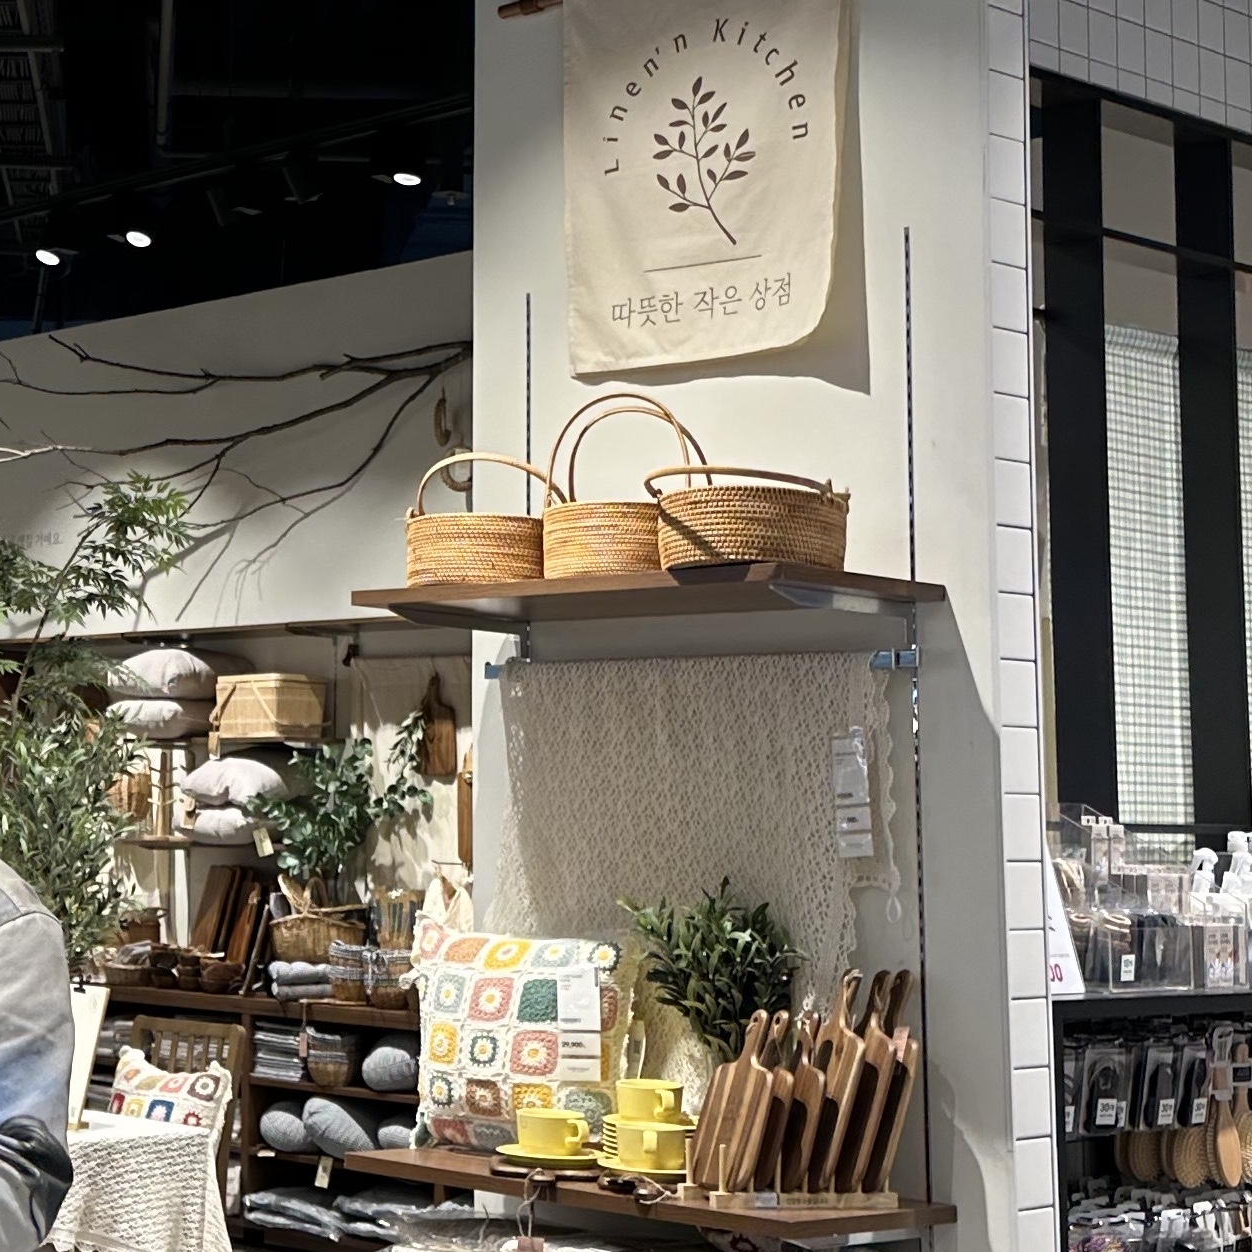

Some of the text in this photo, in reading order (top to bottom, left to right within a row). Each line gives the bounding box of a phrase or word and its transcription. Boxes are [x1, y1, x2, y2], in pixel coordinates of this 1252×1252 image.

[603, 18, 809, 176] Linen'n Kitchen
[611, 272, 791, 328] 따뜻한 작은 상점
